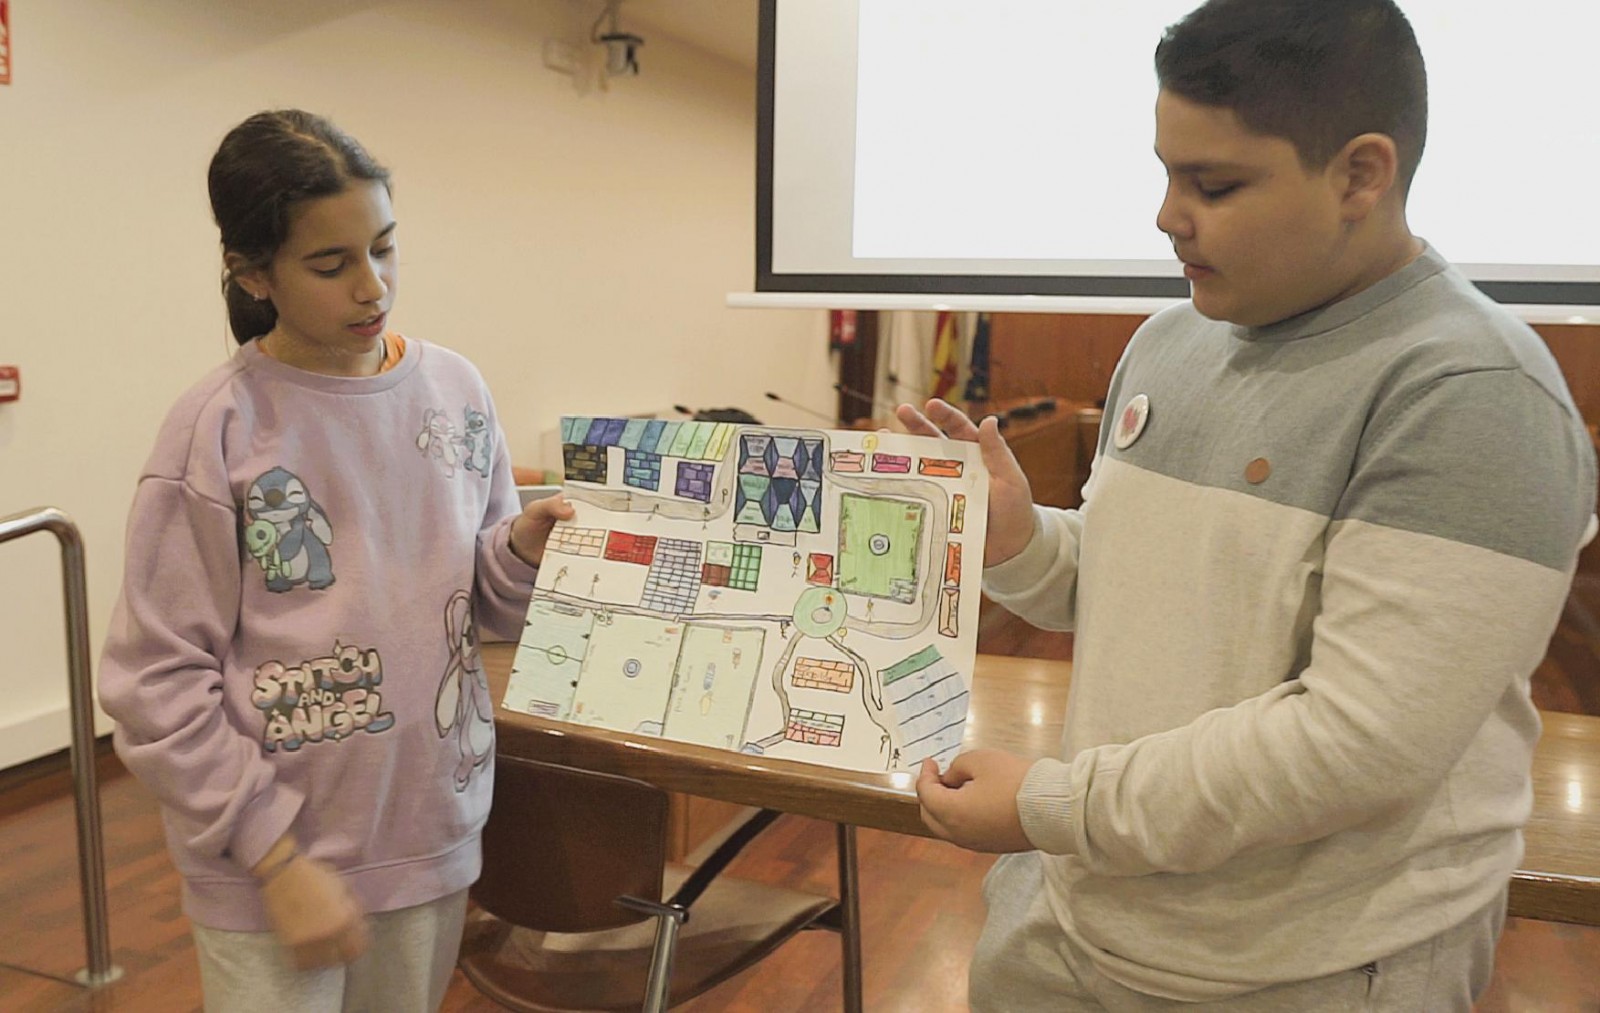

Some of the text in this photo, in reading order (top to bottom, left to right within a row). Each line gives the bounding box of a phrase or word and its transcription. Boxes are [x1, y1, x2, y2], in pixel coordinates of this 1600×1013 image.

[251, 643, 383, 710] STITCH
[299, 688, 335, 708] AND
[264, 688, 395, 752] ANGEL
